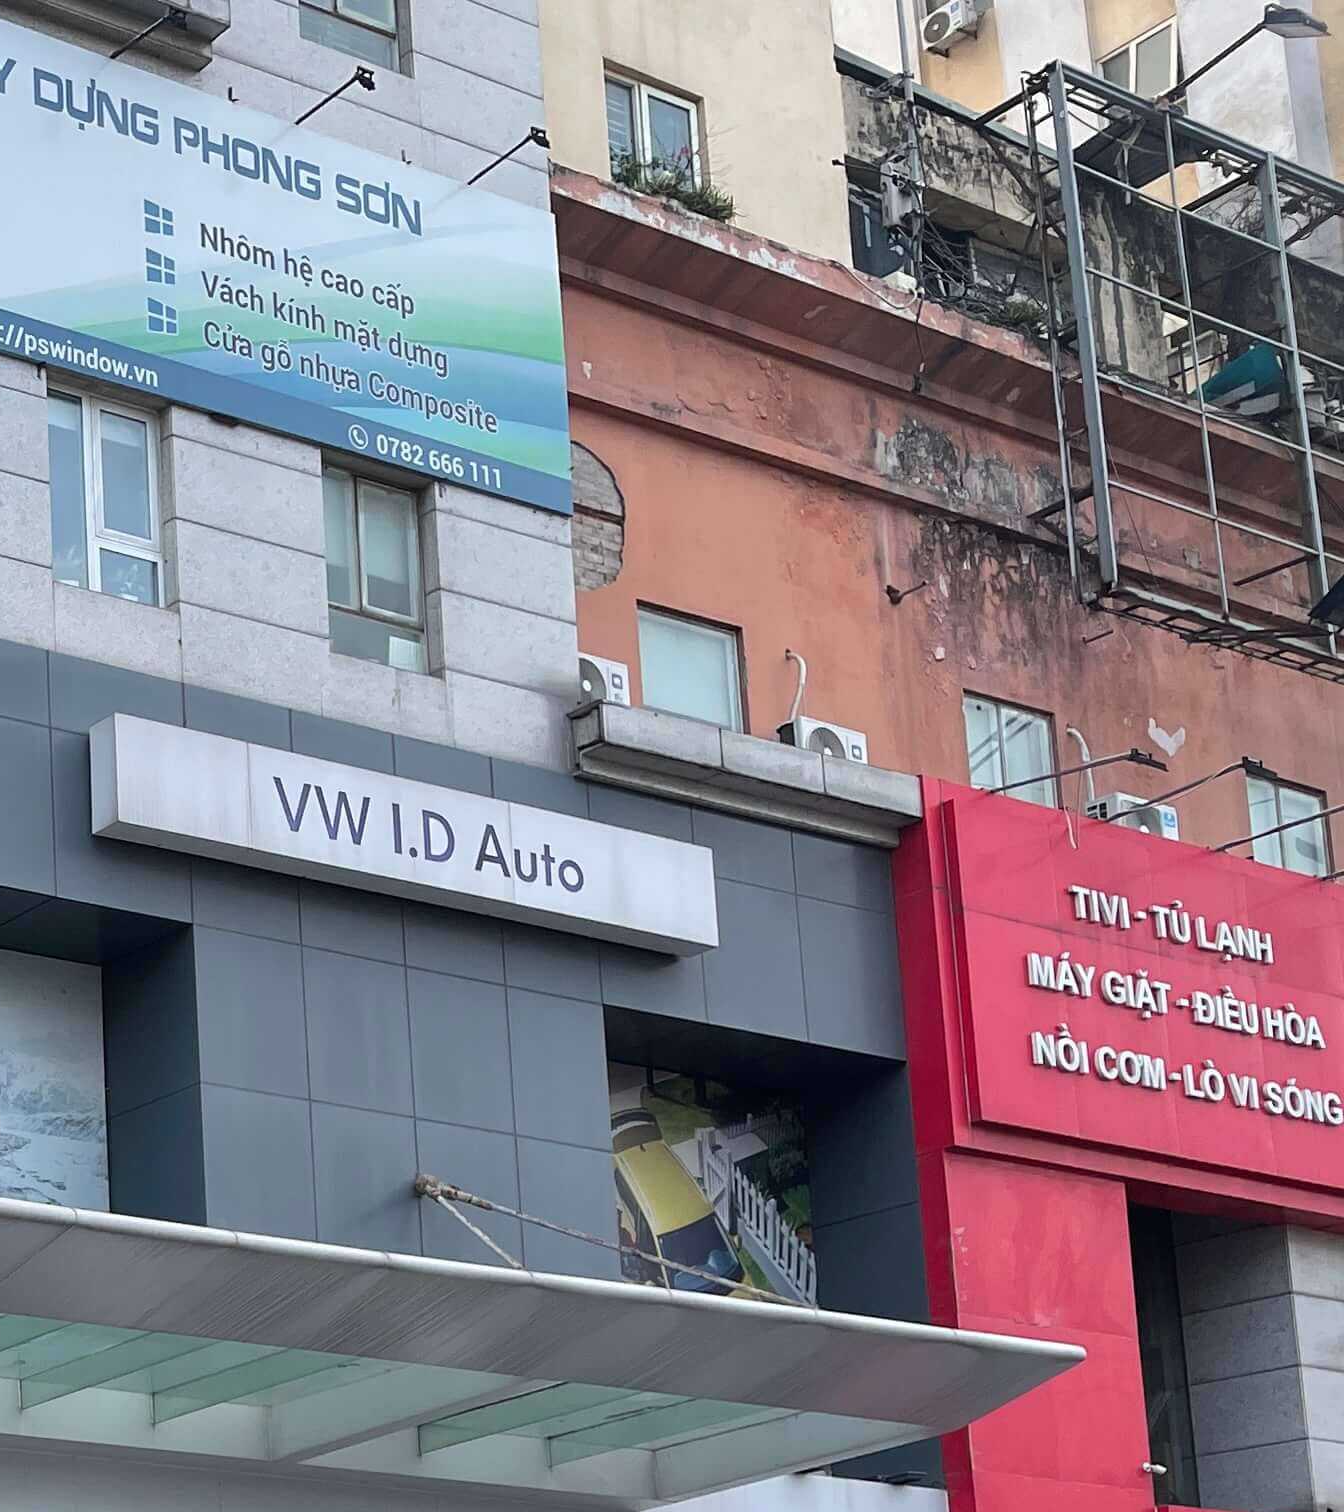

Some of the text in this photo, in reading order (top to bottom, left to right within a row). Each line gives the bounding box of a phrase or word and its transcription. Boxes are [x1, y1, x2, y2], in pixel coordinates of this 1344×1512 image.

[33, 67, 160, 146] DỰNG
[173, 116, 322, 200] PHONG
[336, 174, 422, 236] SƠN
[200, 223, 414, 319] Nhôm hệ cao cấp
[201, 271, 448, 378] Vách kính mặt dựng
[203, 321, 498, 434] Cửa gỗ nhựa Composite
[377, 435, 502, 489] 0782 666 111
[273, 776, 584, 893] VW I.D Auto
[1068, 885, 1130, 930] TIVI
[1151, 901, 1192, 944] TỦ
[1196, 916, 1274, 963] LẠNH
[1027, 952, 1096, 998] MÁY
[1102, 971, 1171, 1019] GIẶT
[1192, 987, 1260, 1035] ĐIỀU
[1264, 1003, 1327, 1048] HÒA
[1030, 1023, 1089, 1075] NỒI
[1096, 1046, 1167, 1091] CƠM
[1183, 1060, 1226, 1102] LÒ
[1229, 1074, 1259, 1109] VI
[1263, 1078, 1344, 1126] SÓNG
